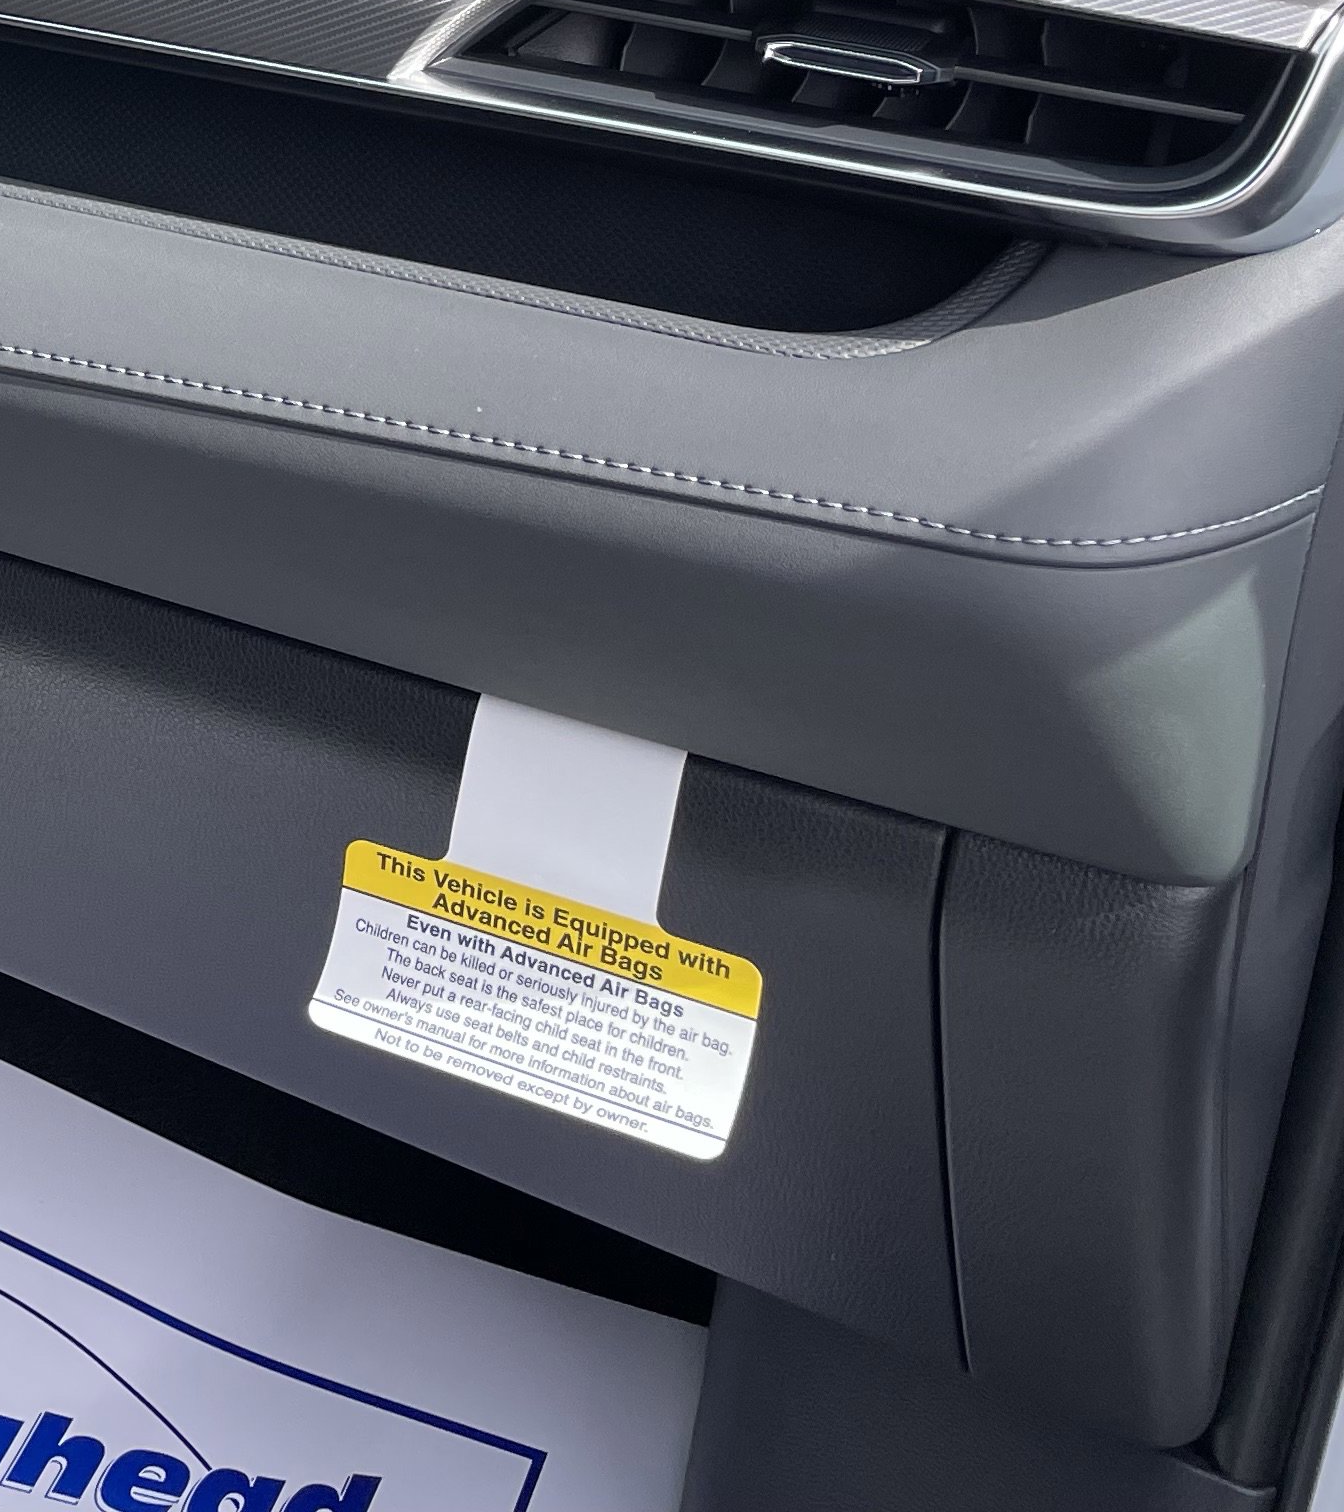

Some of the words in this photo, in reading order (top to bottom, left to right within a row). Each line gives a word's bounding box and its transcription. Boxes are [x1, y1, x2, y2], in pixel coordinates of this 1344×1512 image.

[376, 851, 425, 881] This
[433, 868, 517, 910] Vehicle
[524, 897, 544, 919] is
[553, 907, 670, 959] Equipped
[677, 949, 729, 979] with
[406, 913, 451, 941] Even
[457, 932, 495, 956] with
[499, 945, 595, 988] Advanced
[599, 978, 629, 998] Air
[634, 987, 683, 1017] Bags
[431, 892, 551, 945] Advanced
[555, 932, 593, 957] Air
[599, 944, 662, 980] Bags
[355, 918, 409, 946] Children
[412, 939, 436, 956] can
[439, 945, 456, 962] be
[460, 952, 496, 975] killed
[498, 968, 513, 981] or
[515, 974, 577, 1005] seriously
[580, 991, 629, 1019] injured
[631, 1009, 649, 1029] by
[653, 1016, 675, 1035] the
[678, 1028, 698, 1042] air
[701, 1032, 731, 1056] bag.
[381, 965, 420, 989] Never
[421, 983, 444, 998] put
[447, 991, 456, 1001] a
[459, 994, 532, 1031] rear-facing
[534, 1020, 568, 1040] child
[570, 1033, 601, 1051] seat
[604, 1040, 617, 1057] in
[621, 1047, 644, 1066] the
[647, 1056, 683, 1080] front.
[385, 987, 432, 1013] Always
[435, 1006, 460, 1023] use
[463, 1016, 493, 1034] seat
[495, 1024, 528, 1046] belts
[531, 1039, 559, 1057] and
[561, 1049, 596, 1069] child
[597, 1062, 666, 1094] restraints.
[387, 946, 411, 967] The
[414, 956, 446, 979] back
[448, 971, 478, 990] seat
[480, 979, 492, 994] is
[496, 985, 517, 1002] the
[520, 995, 562, 1018] safest
[564, 1010, 603, 1032] place
[607, 1021, 626, 1039] for
[629, 1031, 688, 1061] children.
[333, 988, 359, 1006] See
[362, 1000, 413, 1025] owner's
[415, 1018, 466, 1043] manual
[467, 1034, 487, 1050] for
[488, 1044, 524, 1064] more
[527, 1054, 605, 1091] information
[608, 1085, 649, 1107] about
[652, 1100, 672, 1113] air
[674, 1104, 713, 1129] bags.
[374, 1027, 401, 1047] Not
[404, 1039, 419, 1053] to
[422, 1044, 442, 1060] be
[446, 1055, 513, 1085] removed
[517, 1080, 569, 1105] except
[572, 1096, 592, 1114] by
[596, 1107, 647, 1132] owner.
